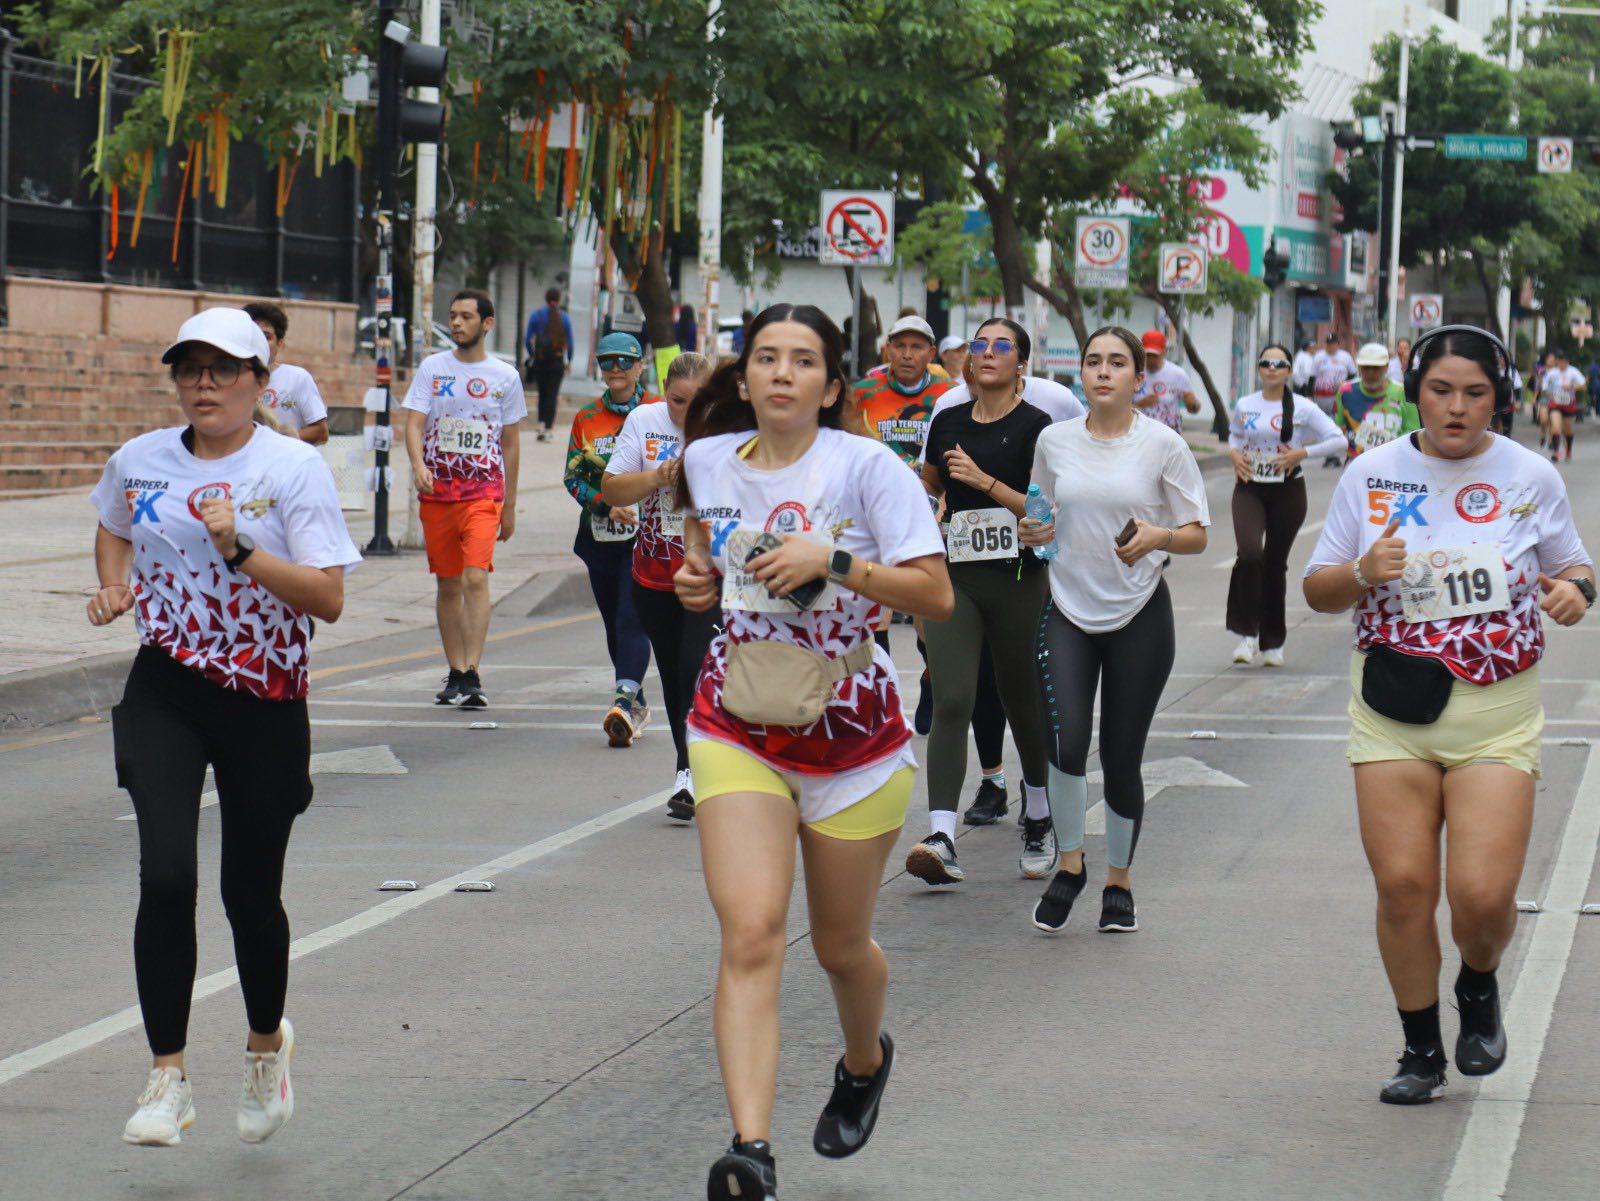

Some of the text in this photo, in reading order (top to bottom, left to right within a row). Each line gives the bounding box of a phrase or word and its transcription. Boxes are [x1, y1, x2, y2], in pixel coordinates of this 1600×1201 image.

[1448, 142, 1523, 156] MIGUEL HIDALGO
[1091, 229, 1115, 249] 30
[877, 420, 930, 433] TODO TERREN
[457, 431, 483, 449] 182
[645, 432, 681, 442] CARRERA
[645, 440, 679, 461] 5K
[1366, 477, 1429, 494] CARRERA
[1367, 490, 1429, 527] 5K
[971, 525, 1013, 553] 056
[1443, 567, 1493, 606] 119
